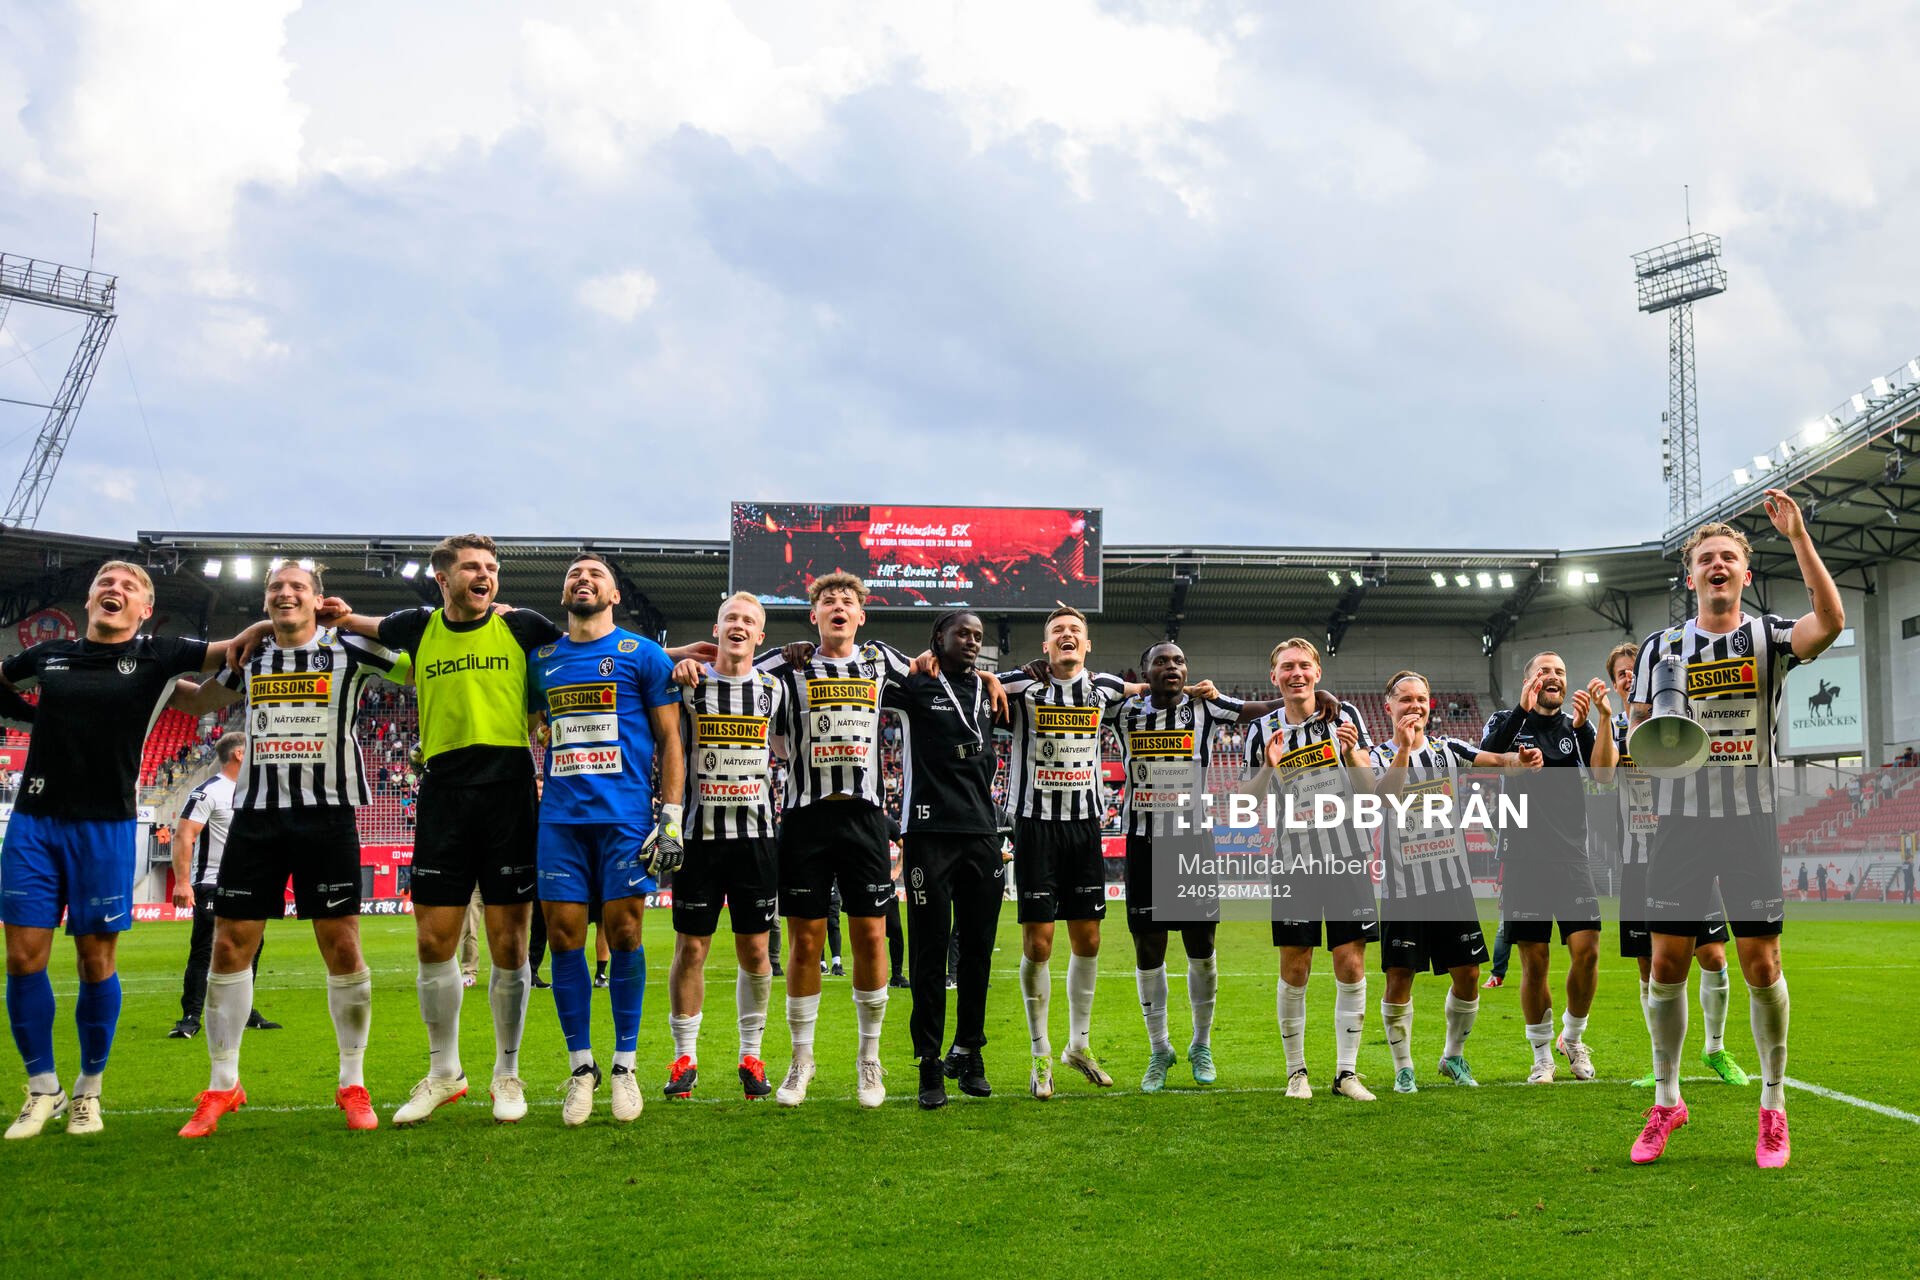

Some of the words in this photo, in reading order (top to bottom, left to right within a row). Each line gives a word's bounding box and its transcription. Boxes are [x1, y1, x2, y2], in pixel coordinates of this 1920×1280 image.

[942, 565, 960, 577] SK
[425, 653, 509, 680] stadium
[1687, 668, 1741, 688] LSSONS
[252, 680, 315, 696] OHLSSONS
[811, 686, 868, 698] OHLSSONS
[274, 715, 322, 723] NÄTVERKET
[1039, 713, 1091, 726] OHLSSONS
[1701, 709, 1751, 719] NÄTVERKET
[1792, 716, 1857, 729] STENBOCKEN
[700, 723, 760, 737] OHLSSONS
[255, 741, 324, 753] FLYTGOLV
[1132, 737, 1182, 749] OHLSSONS
[1710, 740, 1753, 753] GOLV
[555, 750, 617, 766] FLYTGOLV
[1037, 769, 1091, 780] FLYTGOLV
[27, 777, 45, 794] 29
[700, 783, 761, 795] FLYTGOLV
[916, 804, 931, 820] 15
[1403, 838, 1455, 855] FLYTGOLV
[913, 890, 927, 905] 15
[136, 907, 161, 919] DAG
